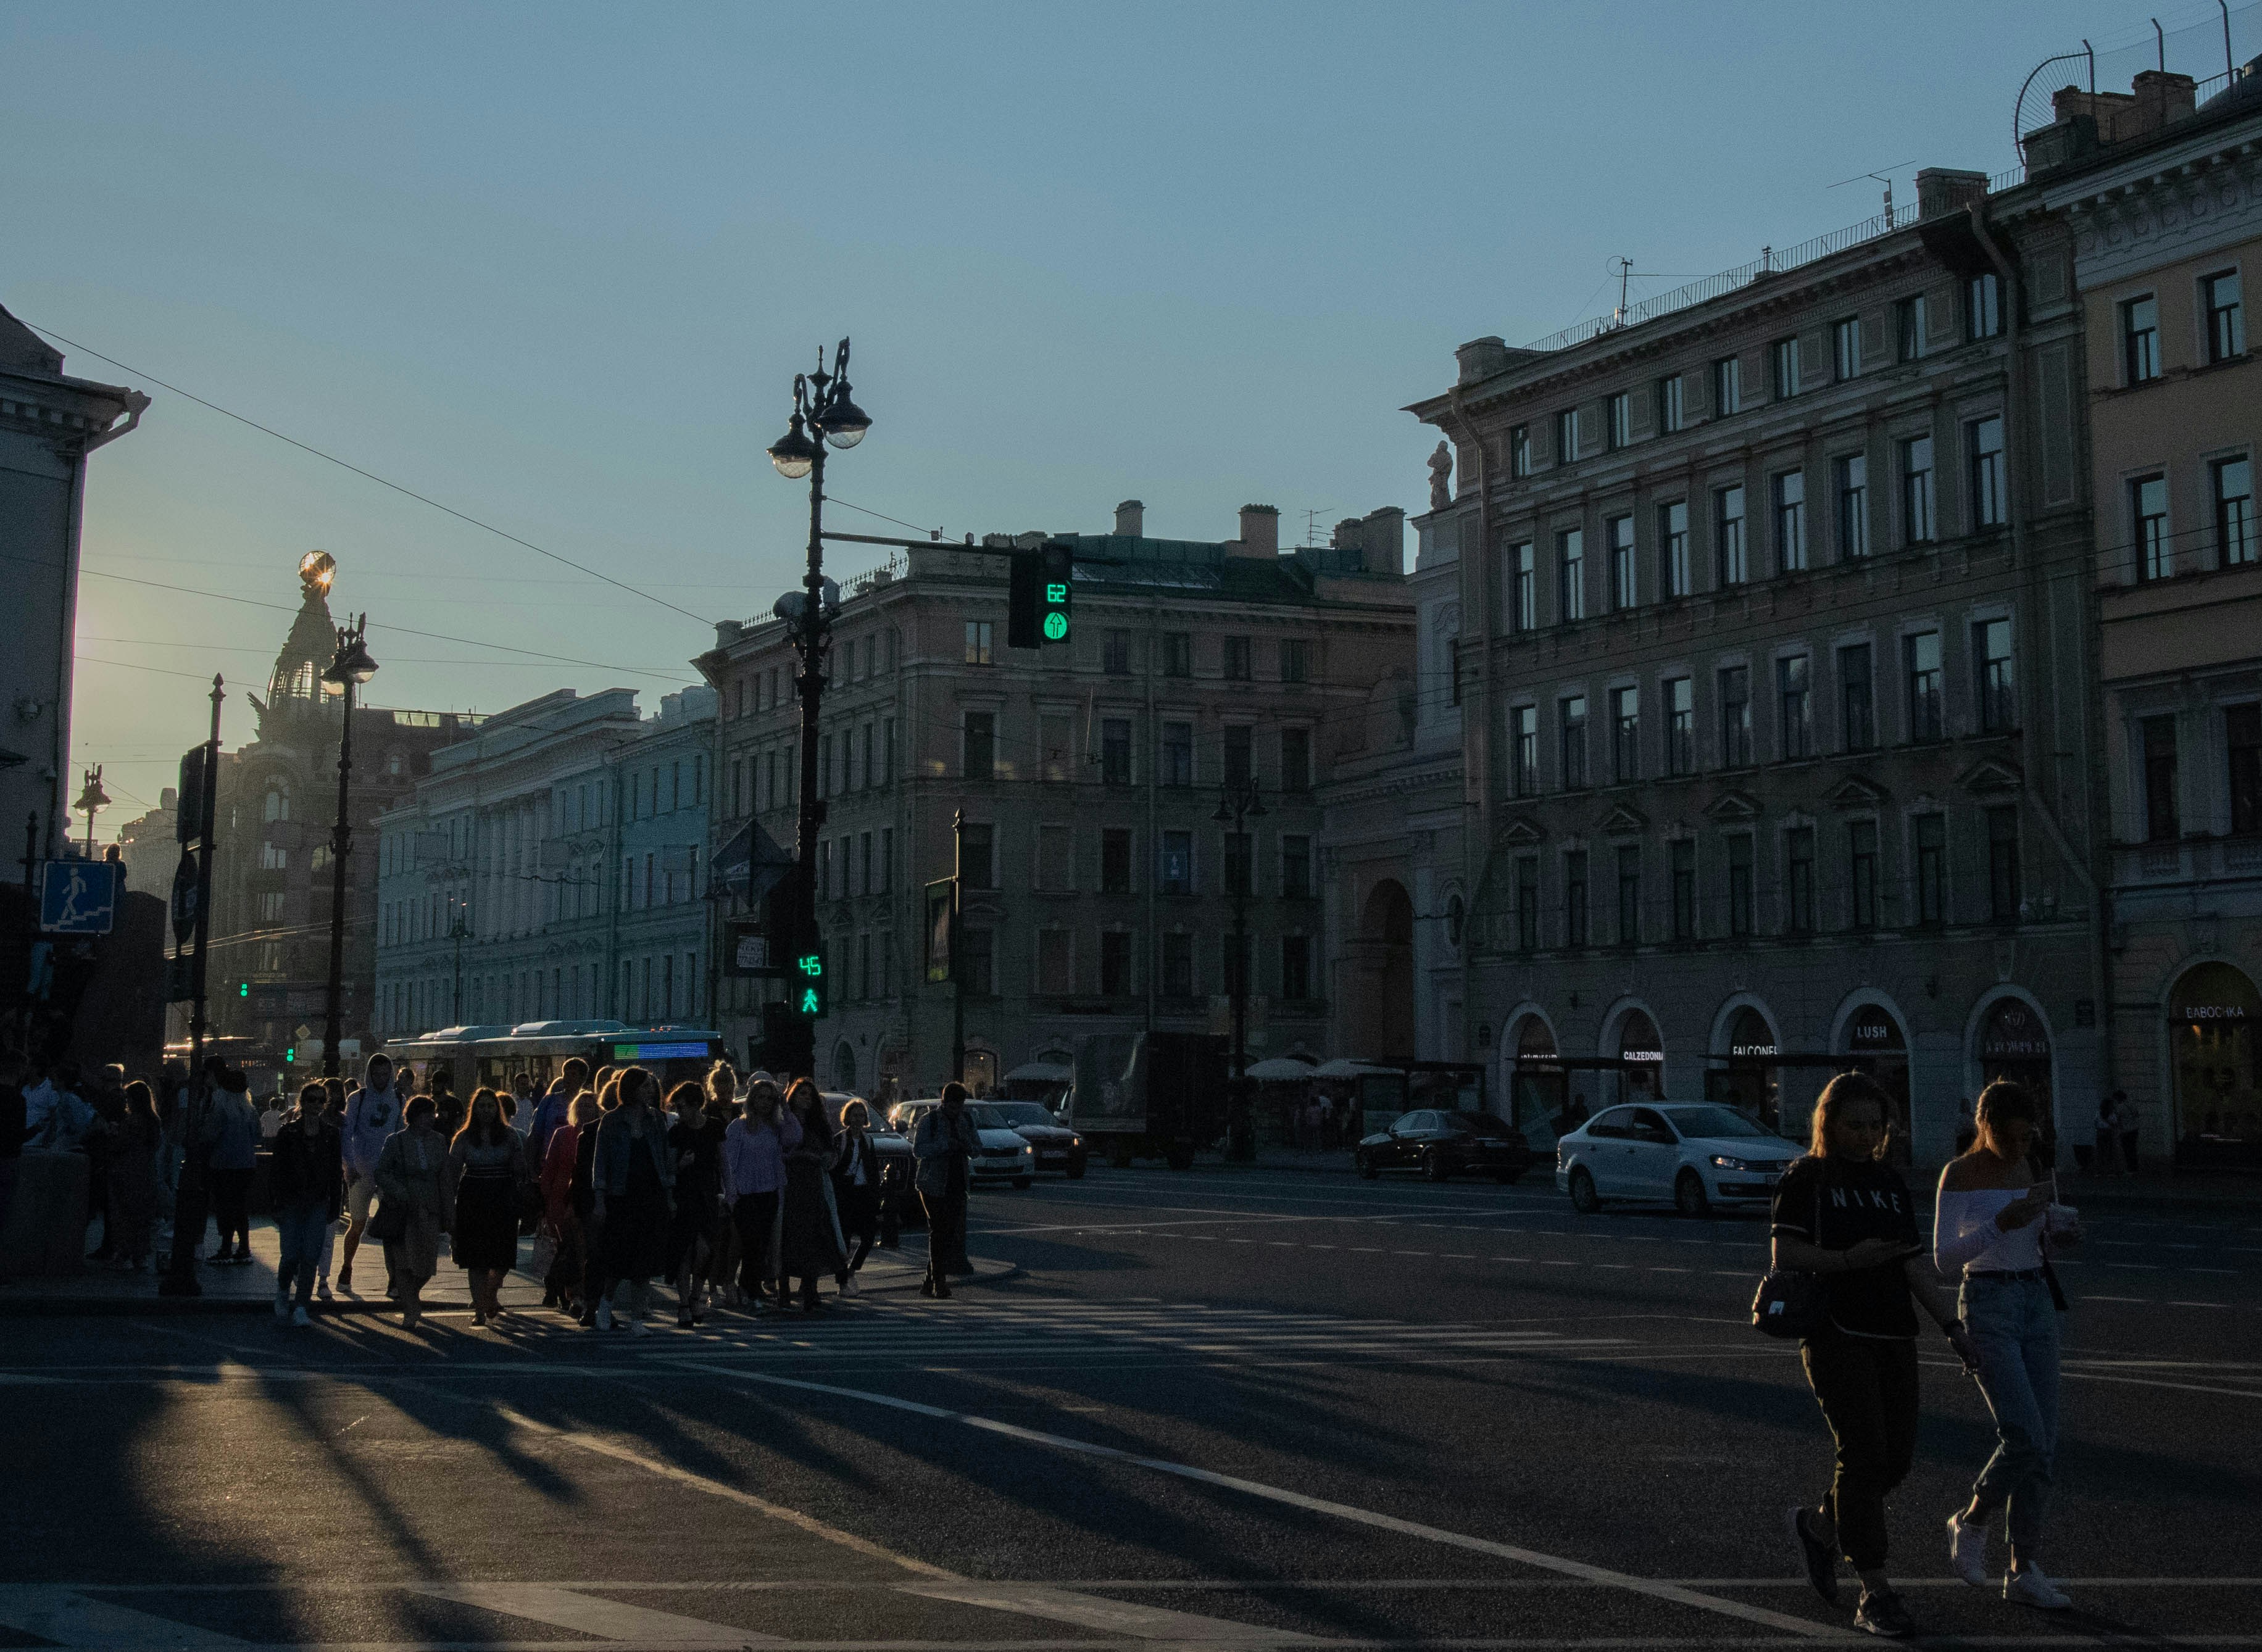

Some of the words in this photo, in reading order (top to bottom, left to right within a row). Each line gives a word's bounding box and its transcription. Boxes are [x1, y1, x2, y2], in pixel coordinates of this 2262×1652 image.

[1047, 584, 1066, 602] 62
[799, 956, 821, 976] 45
[2186, 1006, 2244, 1019] BABOCHKA
[1857, 1026, 1887, 1038] LUSH
[1831, 1187, 1901, 1214] NIKE
